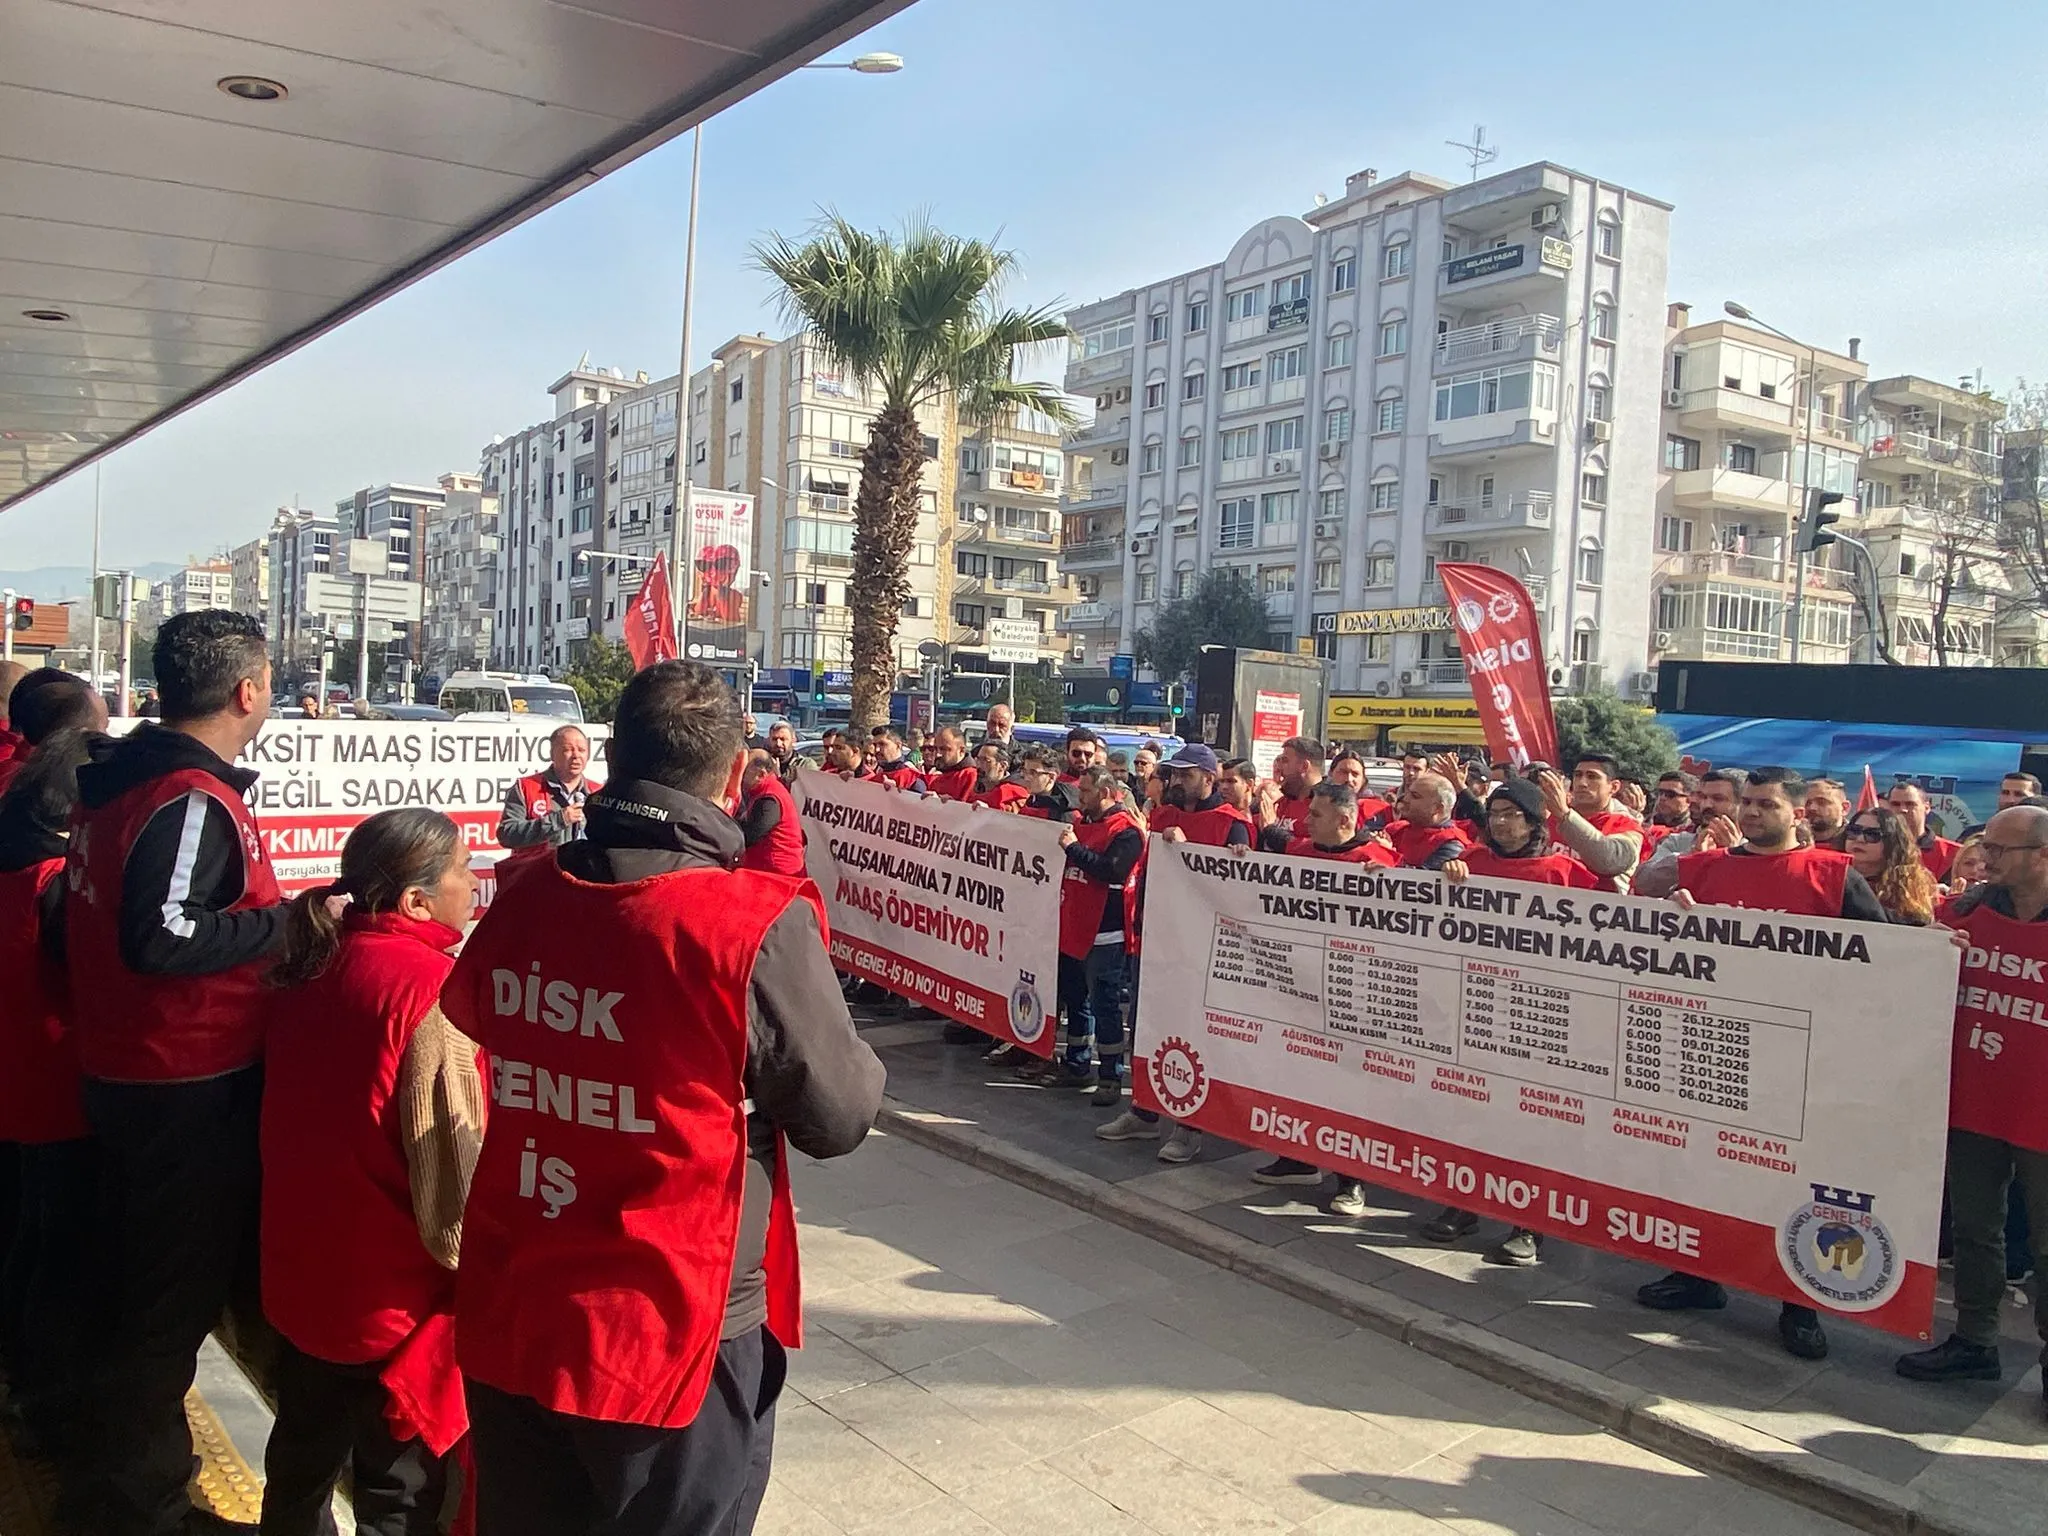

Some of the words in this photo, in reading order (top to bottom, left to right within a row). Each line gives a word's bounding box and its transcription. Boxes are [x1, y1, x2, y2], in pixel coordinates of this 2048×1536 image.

[1000, 647, 1034, 660] Nergiz
[333, 734, 421, 771] MAAŞ
[342, 778, 466, 807] SADAKA
[616, 800, 669, 822] HANSEN
[802, 797, 883, 838] KARŞIYAKA
[886, 818, 964, 860] BELEDİYESİ
[966, 838, 1008, 872] KENT
[1012, 850, 1050, 888] A.Ş.
[830, 839, 938, 893] ÇALIŞANLARINA
[941, 872, 952, 895] 7
[955, 876, 1005, 913] AYDIR
[835, 878, 883, 922] MAAŞ
[886, 889, 989, 957] ÖDEMİYOR
[1181, 850, 1295, 889] KARŞIYAKA
[1300, 869, 1441, 905] BELEDİYESİ
[1448, 884, 1522, 915] KENT
[1526, 895, 1582, 928] A.Ş.
[1590, 903, 1871, 963] ÇALIŞANLARINA
[1259, 893, 1338, 922] TAKSİT
[1345, 905, 1434, 939] TAKSİT
[1439, 912, 1552, 957] ÖDENEN
[1559, 935, 1717, 982] MAAŞLAR
[1329, 939, 1357, 951] NİSAN
[1360, 945, 1375, 954] AYI
[1215, 960, 1243, 972] 10.500
[1216, 949, 1244, 961] 10.000
[1368, 958, 1418, 974] 19.09.2025
[1965, 945, 2047, 983] DİSK
[831, 939, 855, 964] DİSK
[855, 949, 901, 984] GENEL-İŞ
[903, 969, 913, 985] 10
[936, 983, 950, 1003] LU
[954, 990, 985, 1019] ŞUBE
[1212, 971, 1241, 983] KALAN
[1243, 977, 1267, 988] KISIM
[1367, 970, 1418, 986] 03.10.2025
[1467, 962, 1499, 975] MAYIS
[1501, 969, 1520, 979] AYI
[1367, 982, 1418, 998] 10.10.2025
[1466, 975, 1495, 987] 5.000
[1510, 983, 1570, 1000] 21.11.2025
[1466, 987, 1494, 1000] 6.000
[1510, 995, 1569, 1014] 28.11.2025
[1628, 989, 1683, 1006] HAZİRAN
[1686, 1000, 1708, 1010] AYI
[492, 961, 625, 1042] DİSK
[1366, 1006, 1418, 1022] 31.10.2025
[1367, 994, 1418, 1011] 17.10.2025
[1465, 1000, 1494, 1013] 7.500
[1510, 1008, 1569, 1027] 05.12.2025
[1205, 1011, 1243, 1031] TEMMUZ
[1246, 1021, 1263, 1032] AYI
[1372, 1019, 1423, 1036] 07.11.2025
[1465, 1013, 1493, 1026] 4.500
[1509, 1021, 1568, 1041] 12.12.2025
[1626, 1016, 1661, 1030] 7.000
[1682, 1025, 1750, 1046] 30.12.2025
[1627, 1004, 1662, 1018] 4.500
[1682, 1012, 1750, 1033] 26.12.2025
[1207, 1024, 1258, 1045] ÖDENMEDİ
[1281, 1028, 1326, 1048] AĞUSTOS
[1328, 1041, 1344, 1052] AYI
[1329, 1021, 1357, 1034] KALAN
[1360, 1028, 1387, 1040] KISIM
[1401, 1036, 1452, 1055] 14.11.2025
[1465, 1025, 1492, 1038] 5.000
[1509, 1034, 1568, 1054] 19.12.2025
[1626, 1028, 1661, 1043] 6.000
[1681, 1038, 1750, 1059] 09.01.2026
[1969, 1022, 2004, 1061] İŞ
[1286, 1042, 1338, 1064] ÖDENMEDİ
[1365, 1049, 1396, 1066] EYLÜL
[1399, 1059, 1416, 1070] AYI
[1464, 1037, 1497, 1052] KALAN
[1499, 1045, 1531, 1060] KISIM
[1547, 1055, 1609, 1076] 22.12.2025
[1626, 1041, 1661, 1055] 5.500
[1681, 1050, 1749, 1072] 16.01.2026
[1164, 1060, 1191, 1084] DİSK
[1362, 1062, 1416, 1084] ÖDENMEDİ
[1436, 1066, 1465, 1084] EKİM
[1467, 1075, 1486, 1087] AYI
[1625, 1065, 1660, 1080] 6.500
[1679, 1075, 1748, 1098] 30.01.2026
[1626, 1053, 1661, 1068] 6.500
[1680, 1063, 1748, 1085] 23.01.2026
[1430, 1078, 1491, 1104] ÖDENMEDİ
[1520, 1086, 1560, 1105] KASIM
[1563, 1097, 1583, 1110] AYI
[1624, 1078, 1661, 1093] 9.000
[1679, 1088, 1748, 1111] 06.02.2026
[1519, 1100, 1585, 1126] ÖDENMEDİ
[1612, 1107, 1662, 1128] ARALIK
[1666, 1120, 1689, 1134] AYI
[1613, 1121, 1687, 1149] ÖDENMEDİ
[1718, 1130, 1760, 1149] OCAK
[1762, 1141, 1787, 1155] AYI
[1717, 1144, 1797, 1175] ÖDENMEDİ
[519, 1138, 578, 1218] İŞ
[1250, 1104, 1312, 1144] DİSK
[1315, 1125, 1437, 1186] GENEL-İŞ
[1444, 1162, 1475, 1194] 10
[1547, 1189, 1589, 1226] LU
[1606, 1206, 1700, 1259] ŞUBE
[1812, 1205, 1872, 1232] GENEL-İŞ
